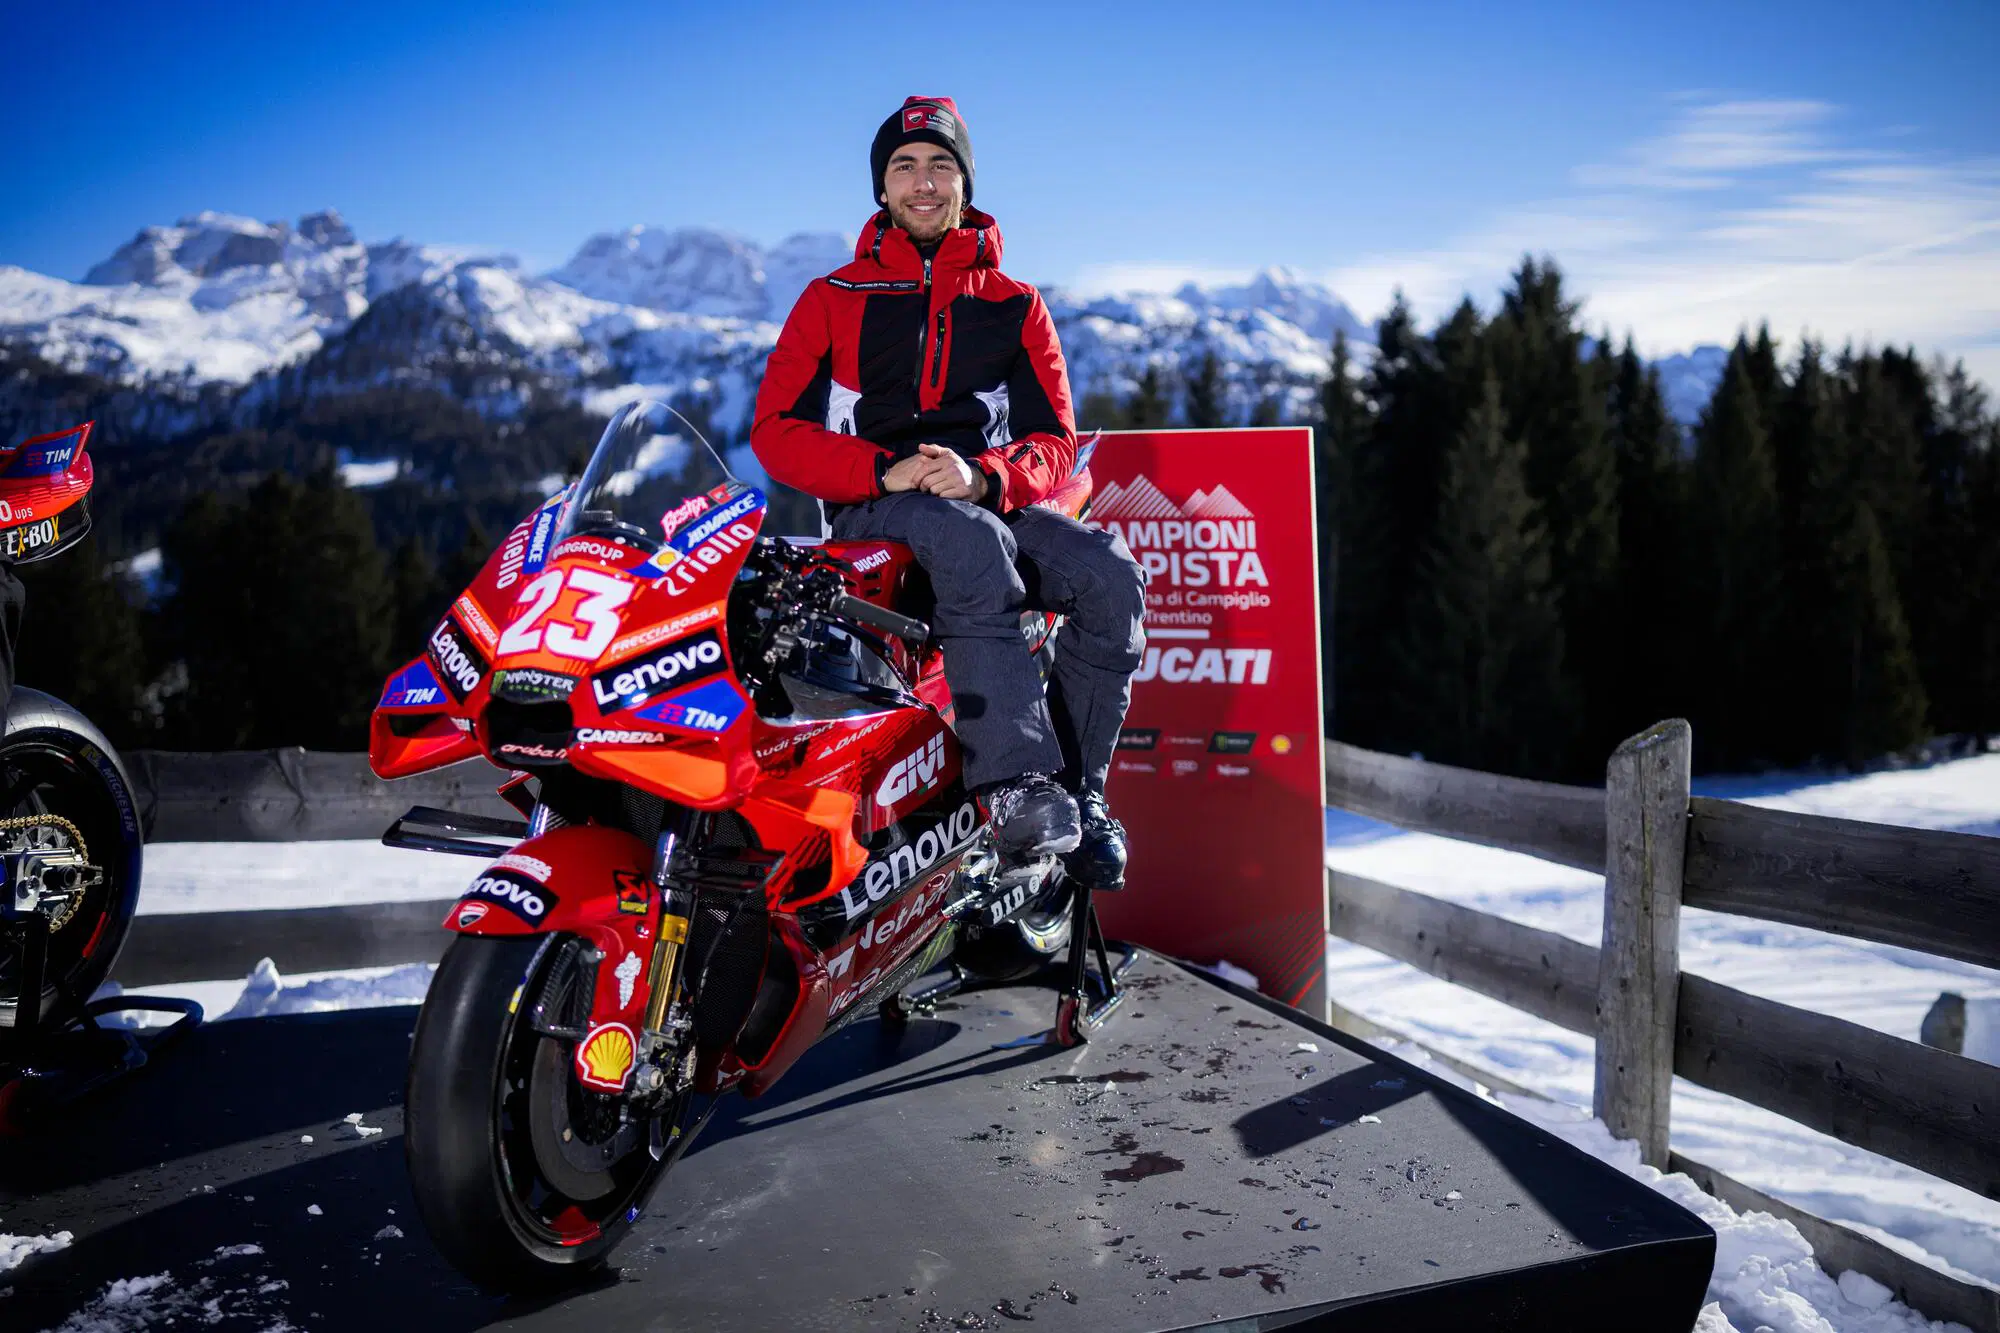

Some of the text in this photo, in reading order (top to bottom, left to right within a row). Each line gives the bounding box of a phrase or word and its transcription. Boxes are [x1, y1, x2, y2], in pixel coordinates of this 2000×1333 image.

[46, 448, 71, 464] TIM
[14, 506, 33, 520] ups
[0, 516, 59, 557] EX-BOX
[853, 549, 892, 573] DUCATI
[1141, 551, 1269, 588] PISTA
[1166, 590, 1182, 606] di
[1186, 590, 1271, 611] Campiglio
[497, 569, 634, 659] 23
[1145, 610, 1213, 625] Trentino
[1023, 617, 1046, 640] ovo
[431, 620, 480, 692] Lenovo
[1131, 647, 1273, 685] UCATI
[504, 670, 574, 693] MONSTER
[592, 640, 722, 705] Lenovo
[404, 688, 438, 704] TIM
[684, 707, 728, 731] TIM
[577, 728, 665, 744] CARRERA
[792, 720, 836, 745] Sport
[876, 731, 945, 807] GIVI
[840, 803, 975, 921] Lenovo
[464, 877, 544, 916] novo
